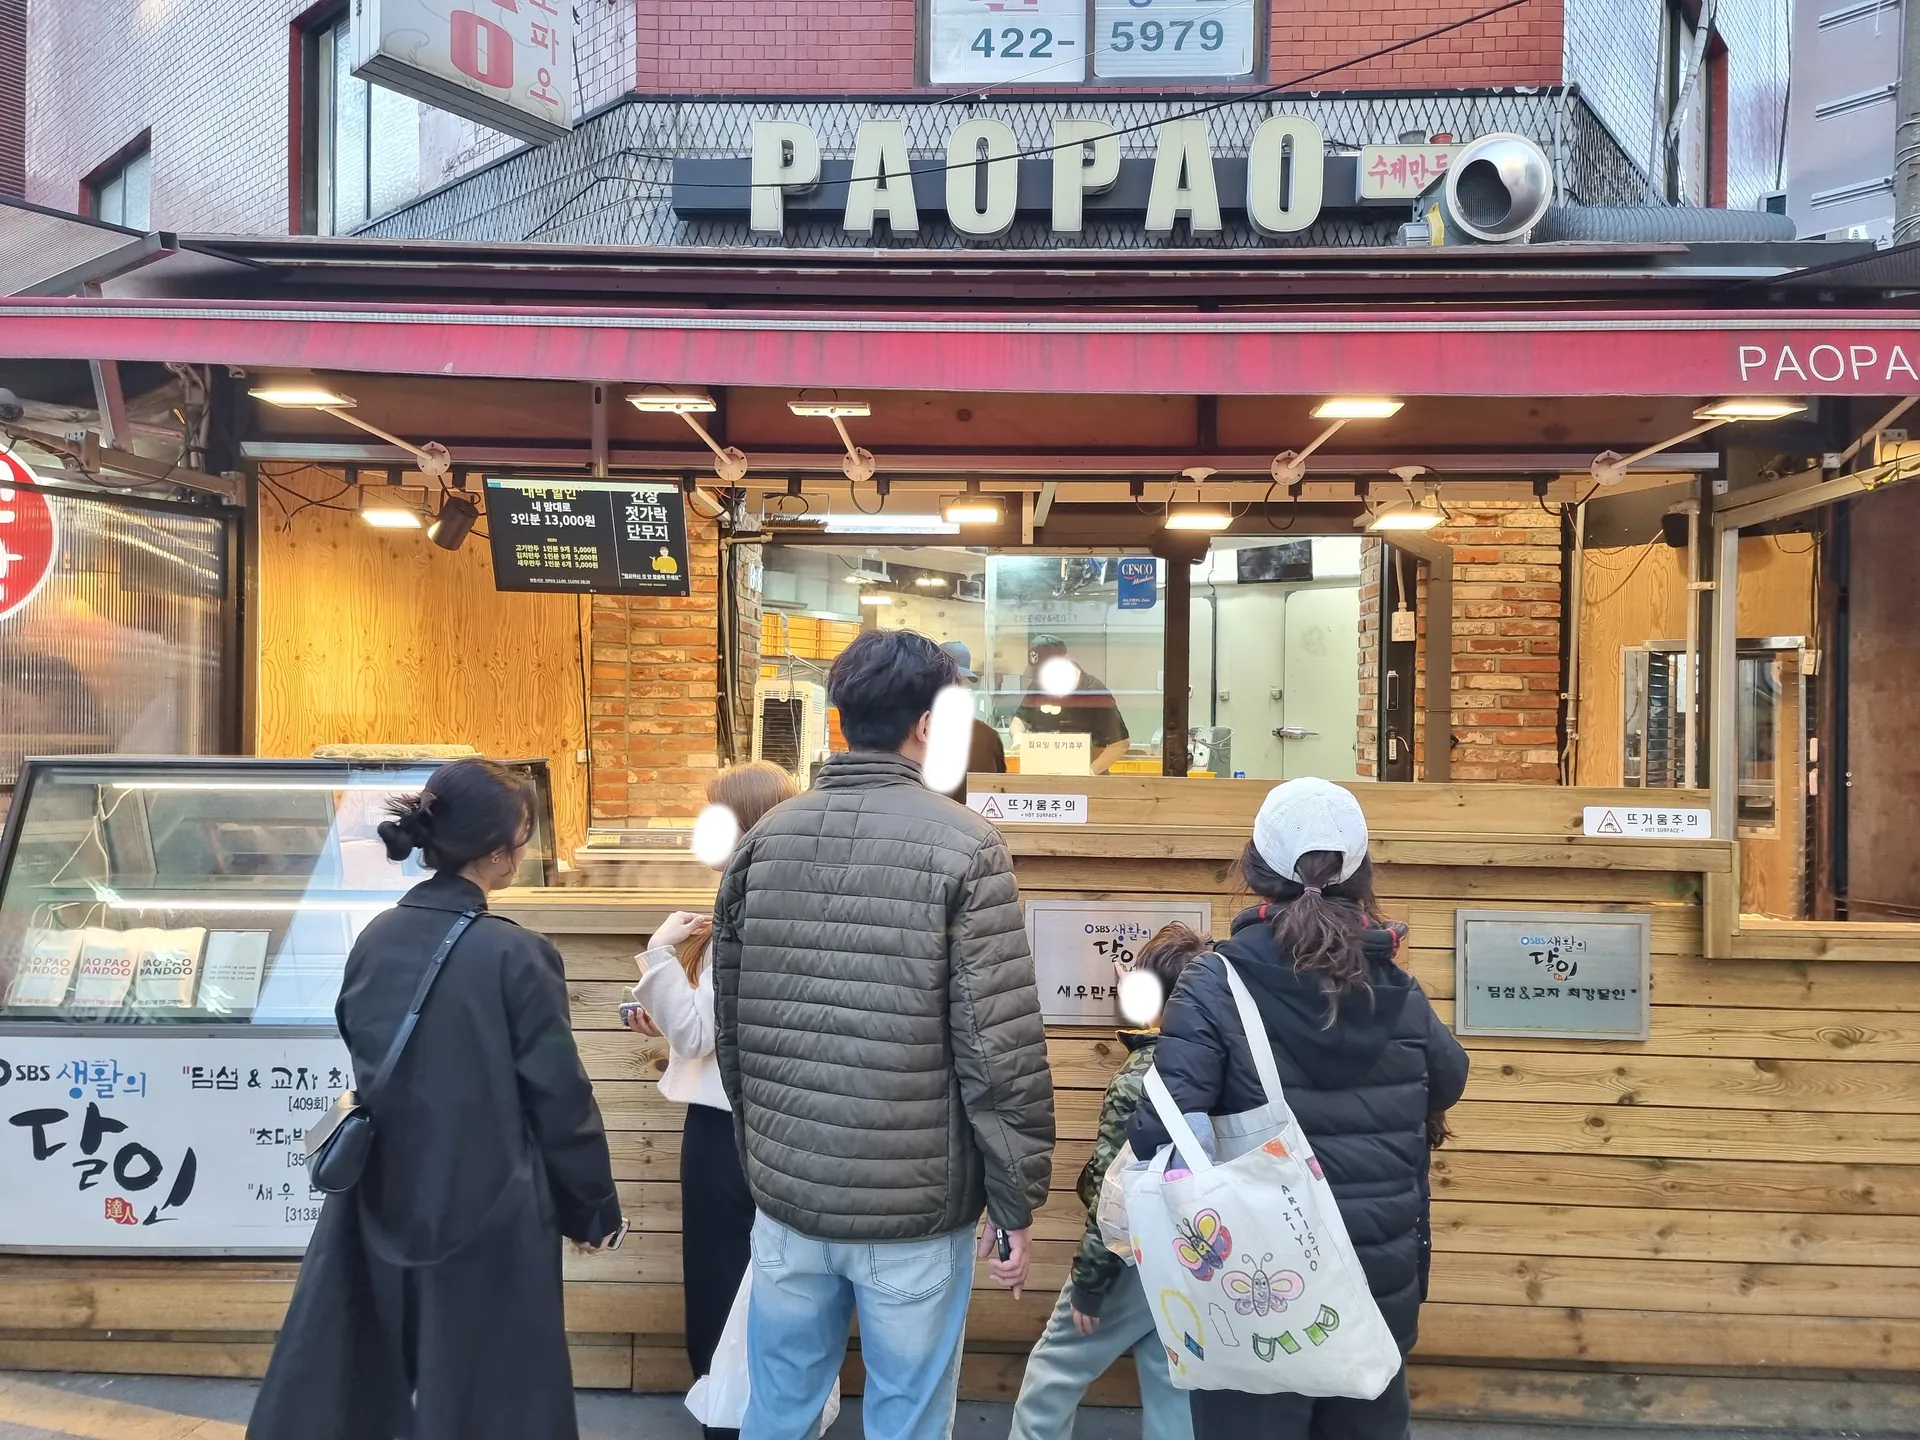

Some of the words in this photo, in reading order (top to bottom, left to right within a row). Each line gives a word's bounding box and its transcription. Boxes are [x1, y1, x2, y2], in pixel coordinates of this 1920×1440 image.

[970, 28, 1075, 58] 422-
[1111, 20, 1224, 51] 5979
[750, 115, 1324, 236] PAOPAO
[1739, 345, 1920, 381] PAOPA
[531, 501, 541, 512] 내
[543, 502, 571, 512] 맘대로
[625, 506, 667, 522] 젓가락
[511, 513, 541, 526] 3인분
[544, 514, 596, 528] 13,000원
[627, 524, 669, 540] 단무지
[573, 546, 597, 554] 5,000원
[574, 554, 598, 562] 5,000원
[1121, 563, 1153, 575] CESCO
[1028, 741, 1050, 749] 월요일
[1053, 741, 1083, 749] 정기휴무
[1008, 799, 1075, 811] 뜨거움주의
[1627, 813, 1698, 826] 뜨거움주의
[24, 965, 70, 976] ANDOO
[104, 958, 131, 967] PAO
[1528, 950, 1577, 981] 달인
[80, 966, 131, 976] ANDOO
[56, 1059, 147, 1099] 생활의
[247, 1068, 262, 1089] &
[271, 1067, 318, 1090] 교자
[327, 1067, 349, 1090] 최
[289, 1096, 328, 1112] [409회]
[9, 1101, 198, 1226] 달인
[287, 1151, 305, 1168] [35
[286, 1206, 321, 1222] [313회
